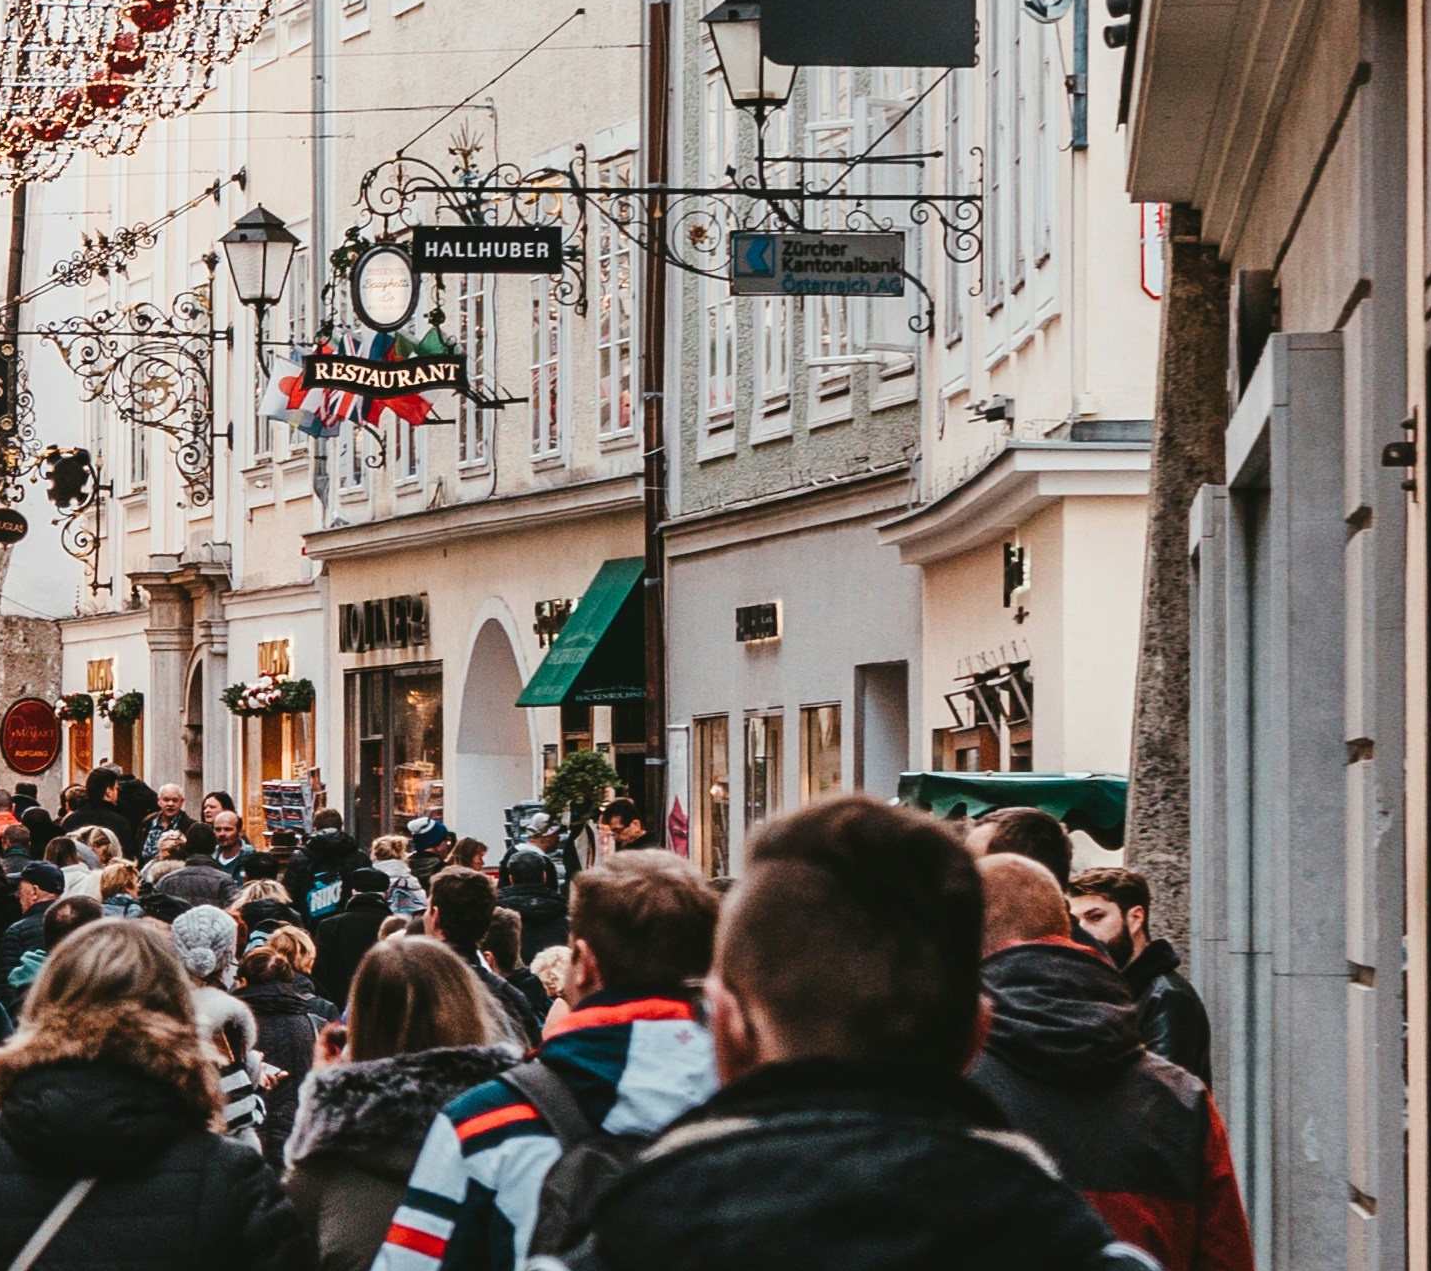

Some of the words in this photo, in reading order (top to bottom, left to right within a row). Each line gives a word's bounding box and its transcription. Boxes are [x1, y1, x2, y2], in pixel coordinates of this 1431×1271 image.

[425, 241, 550, 259] HALLHUBER
[782, 240, 848, 257] Zürcher
[782, 257, 901, 274] Kantonalbank
[782, 274, 871, 293] Österreich
[315, 362, 460, 389] RESTAURANT
